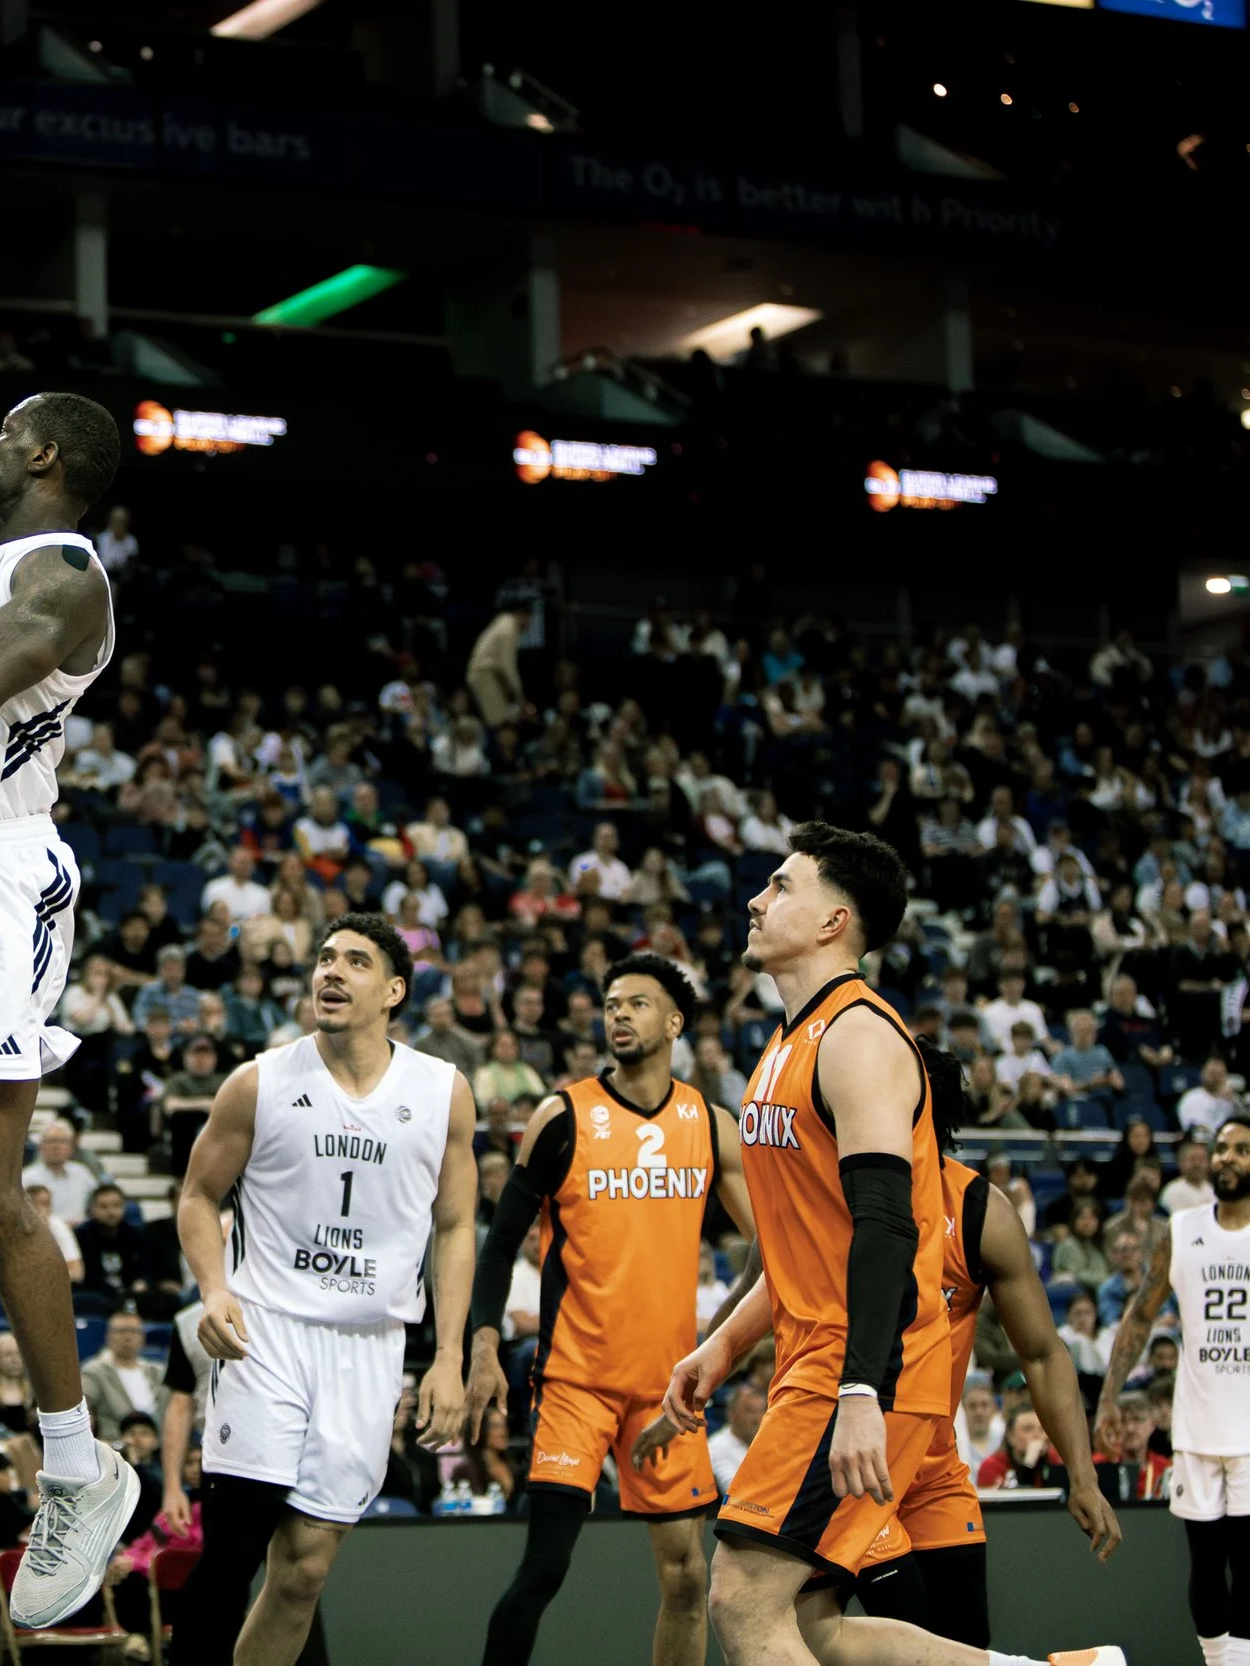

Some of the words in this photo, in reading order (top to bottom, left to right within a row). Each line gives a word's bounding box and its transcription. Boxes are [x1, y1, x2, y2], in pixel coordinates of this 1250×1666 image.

[226, 118, 312, 161] bars
[568, 153, 634, 194] The
[736, 175, 842, 214] better
[941, 197, 1062, 247] Priority
[753, 1043, 793, 1101] 11
[314, 1134, 387, 1165] LONDON
[635, 1122, 667, 1168] 2
[340, 1171, 354, 1217] 1
[588, 1166, 707, 1200] PHOENIX
[314, 1224, 363, 1250] LIONS
[293, 1249, 377, 1279] BOYLE
[319, 1277, 376, 1297] SPORTS
[1204, 1288, 1248, 1321] 22
[1207, 1328, 1241, 1344] LIONS
[1200, 1347, 1250, 1362] BOYLE
